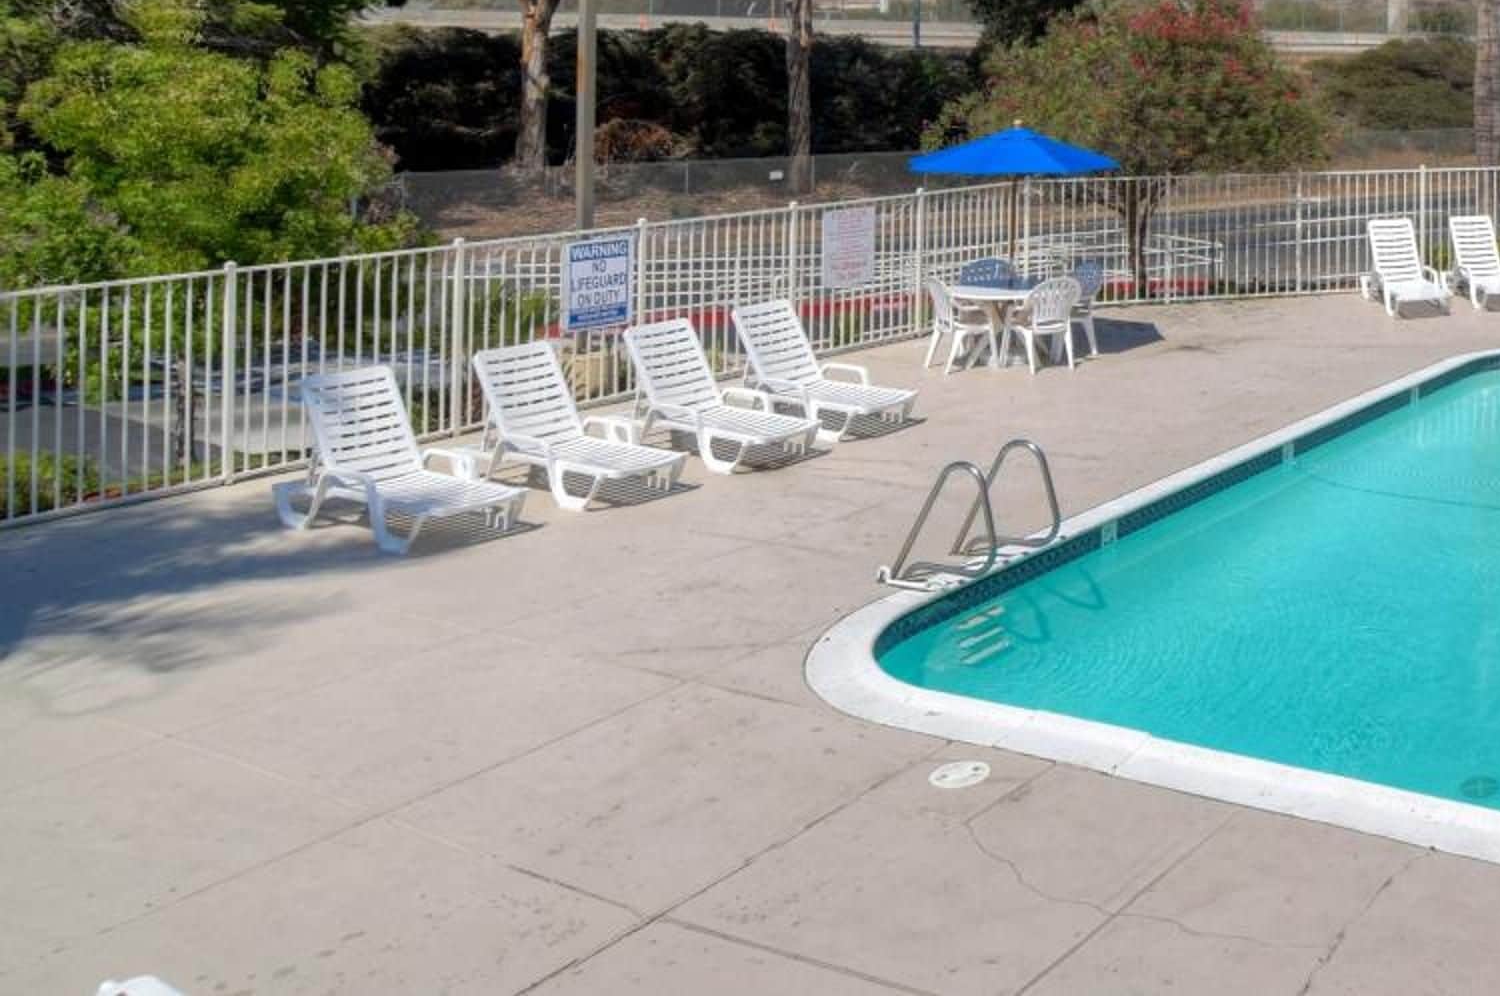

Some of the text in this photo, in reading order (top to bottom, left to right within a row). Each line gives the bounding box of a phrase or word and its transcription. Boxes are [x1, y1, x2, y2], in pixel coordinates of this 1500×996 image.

[571, 241, 627, 260] WARNING
[592, 260, 607, 273] NO
[570, 273, 626, 292] LIFEGUARD
[578, 291, 619, 307] ON DUTY
